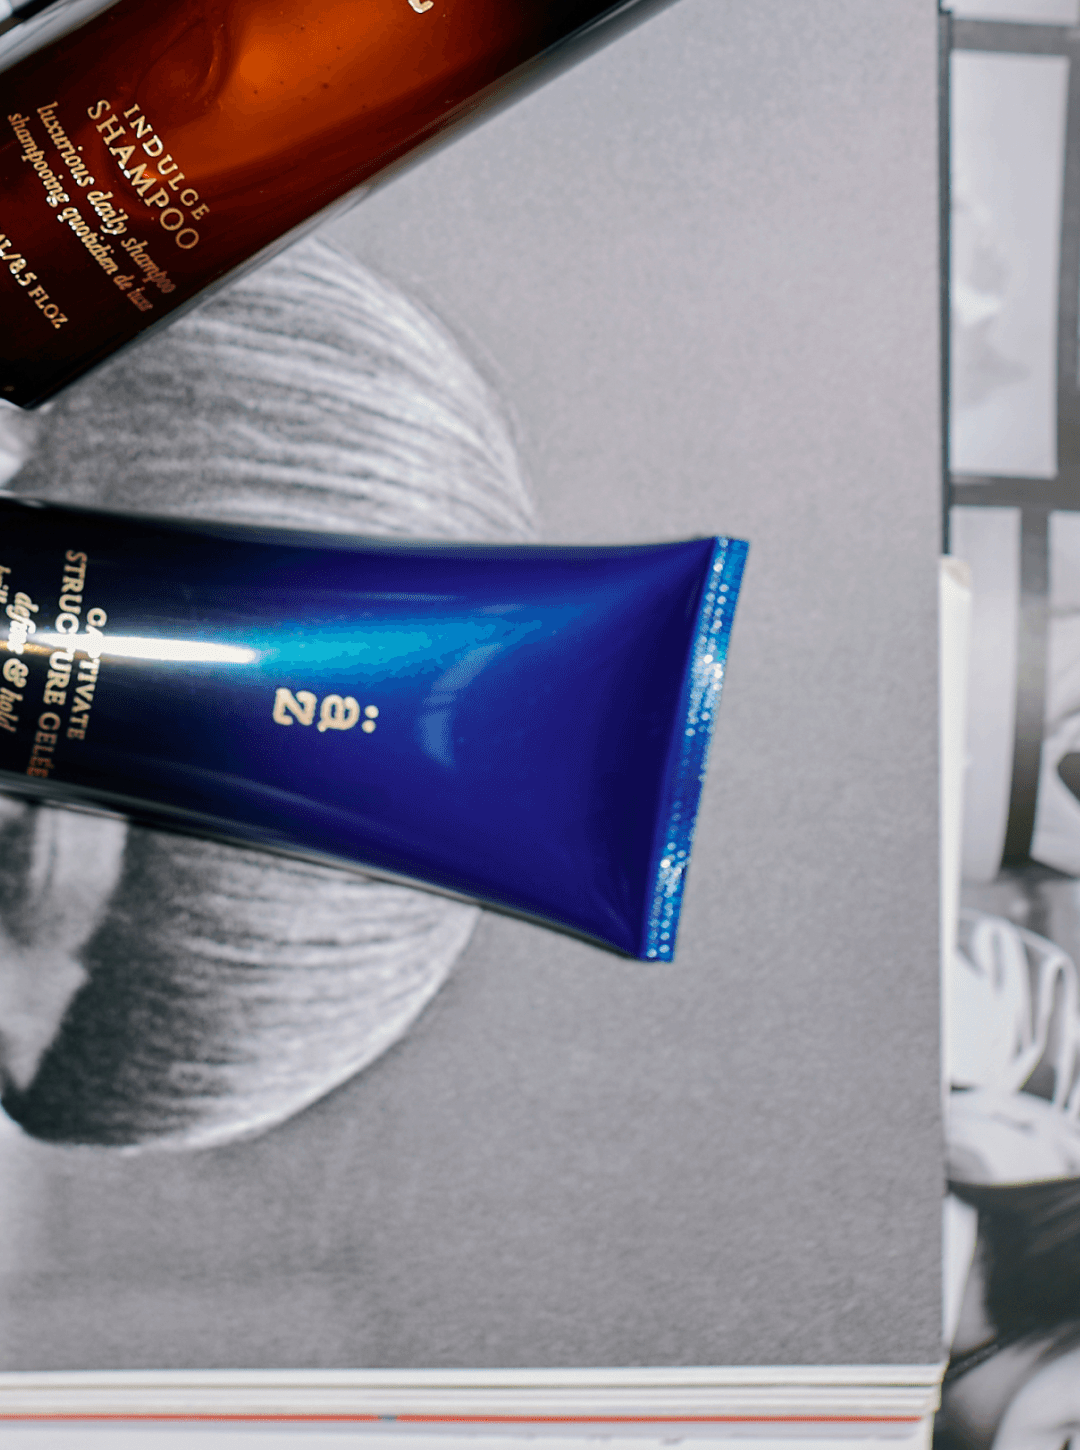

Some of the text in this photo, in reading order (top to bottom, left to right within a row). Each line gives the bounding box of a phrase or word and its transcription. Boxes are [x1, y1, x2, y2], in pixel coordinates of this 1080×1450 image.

[8, 113, 70, 208] shampooing
[56, 206, 119, 276] quotidien
[112, 274, 136, 291] de
[36, 101, 176, 293] luxurious daily shampoo
[87, 99, 199, 249] SHAMPOO
[123, 103, 210, 221] INDULGE
[27, 284, 69, 330] FLOZ
[2, 657, 30, 689] &
[26, 549, 88, 779] STRUCURE GELÉE
